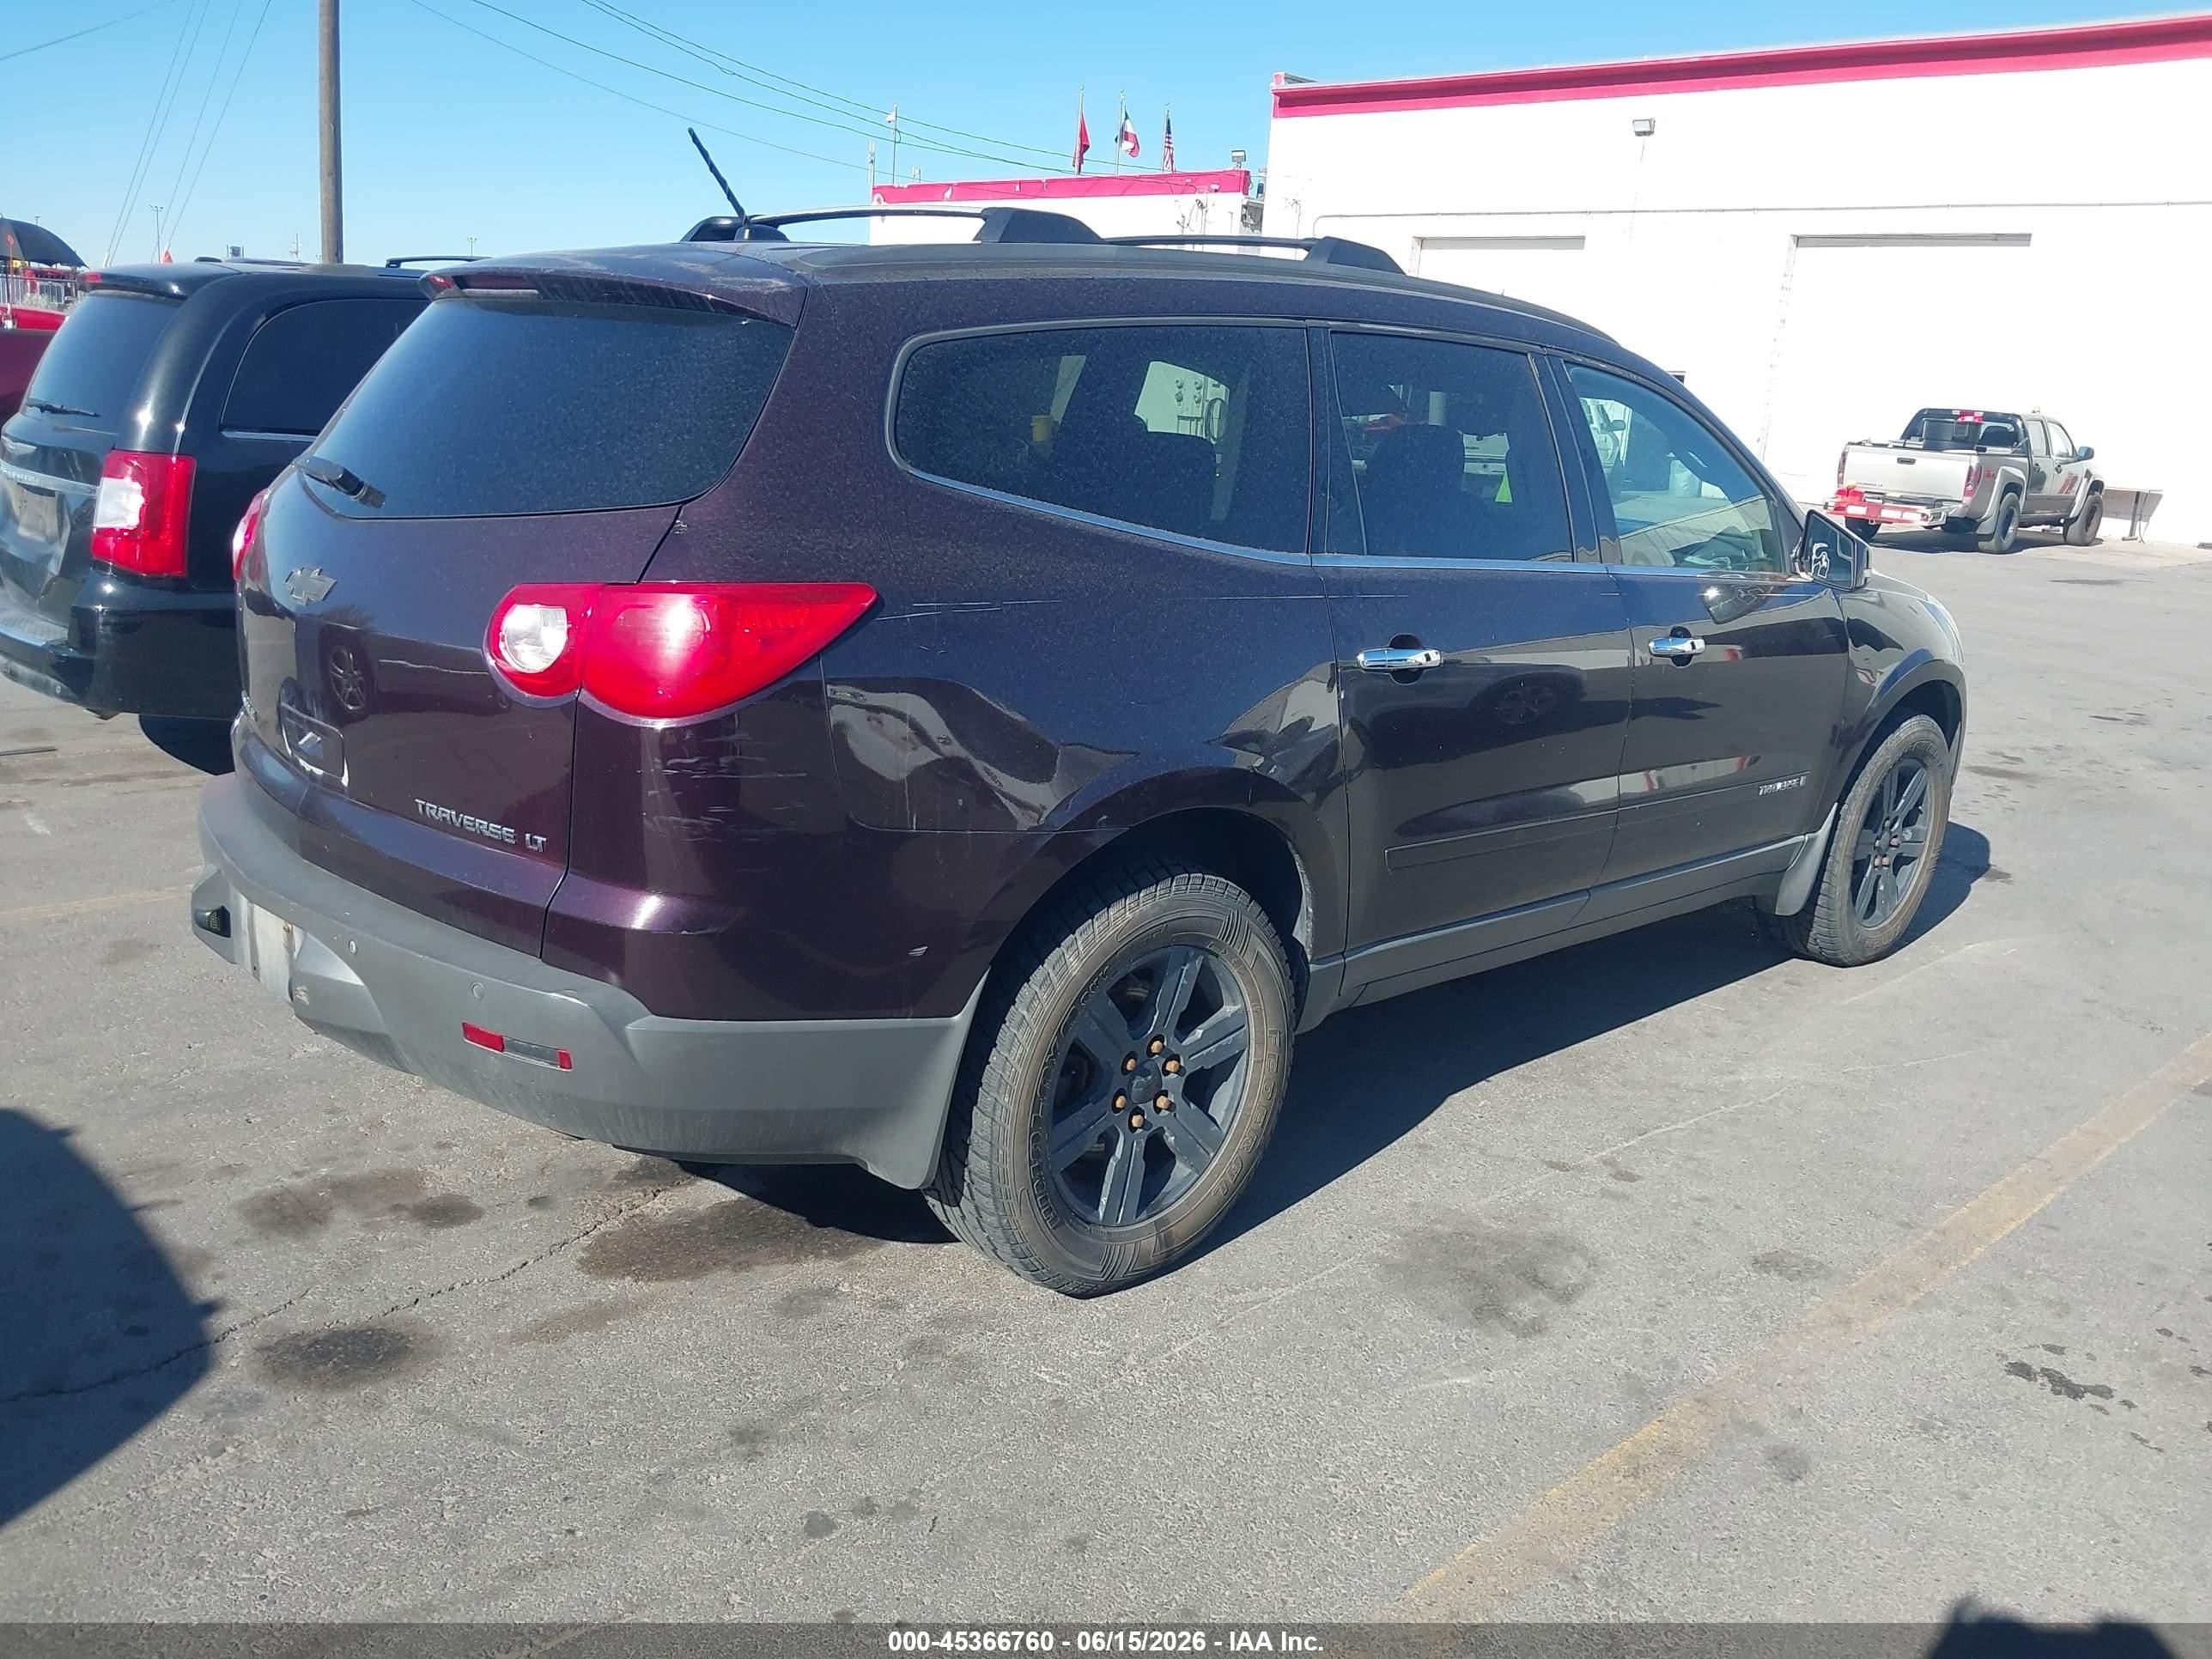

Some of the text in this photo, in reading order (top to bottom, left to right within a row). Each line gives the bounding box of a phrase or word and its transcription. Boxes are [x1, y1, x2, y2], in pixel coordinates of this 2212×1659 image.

[415, 799, 549, 853] TRAVERSE LT
[1211, 1029, 1282, 1198] FEDERAL
